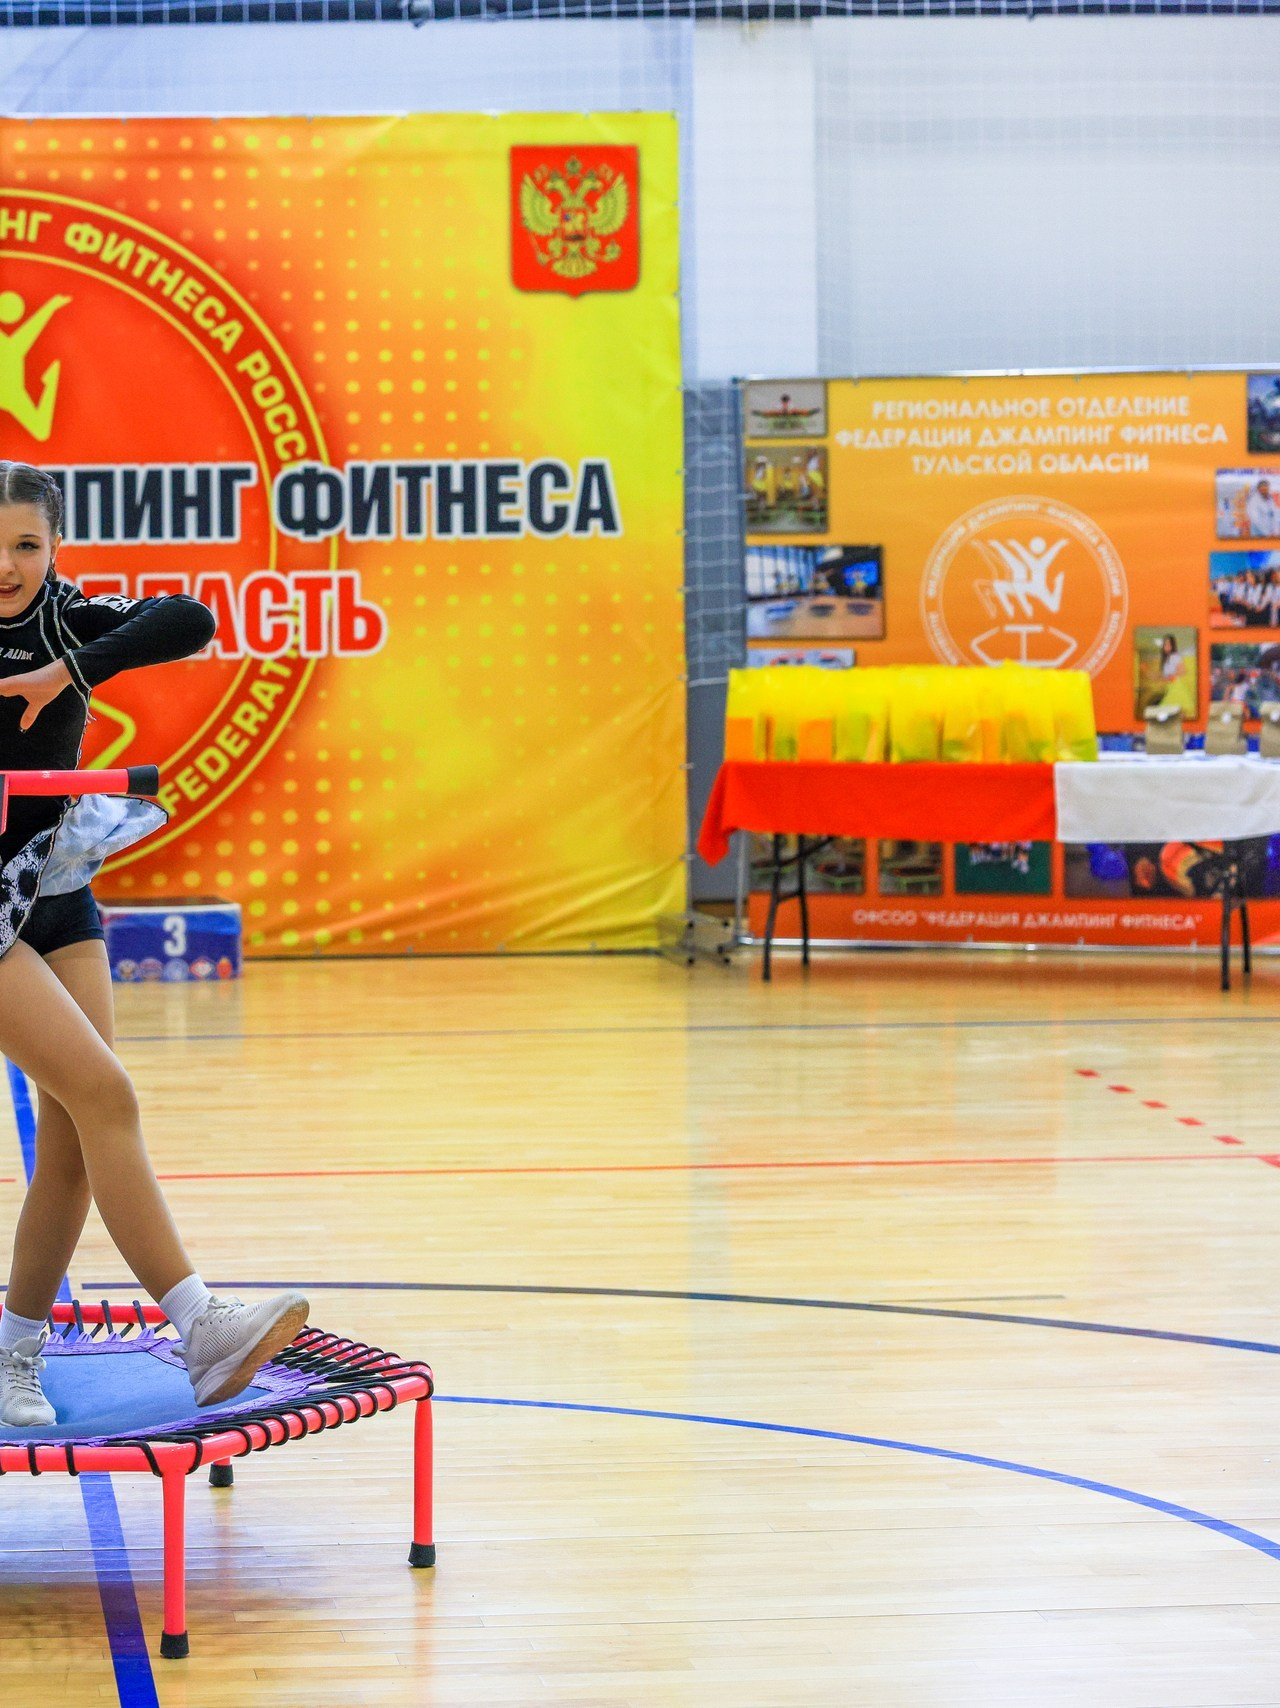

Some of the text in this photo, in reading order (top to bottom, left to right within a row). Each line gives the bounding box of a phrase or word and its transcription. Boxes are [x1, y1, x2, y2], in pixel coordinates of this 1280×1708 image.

[64, 222, 244, 354] ФИТНЕСА
[236, 350, 308, 469] РОСС
[872, 395, 1190, 420] РЕГИОНАЛЬНОЕ ОТДЕЛЕНИЕ
[835, 423, 1228, 449] ФЕДЕРАЦИИ ДЖАМПИНГ ФИТНЕСА
[912, 449, 1150, 475] ТУЛЬСКОЙ ОБЛАСТИ
[273, 457, 621, 541] ФИТНЕСА
[163, 915, 186, 957] 3
